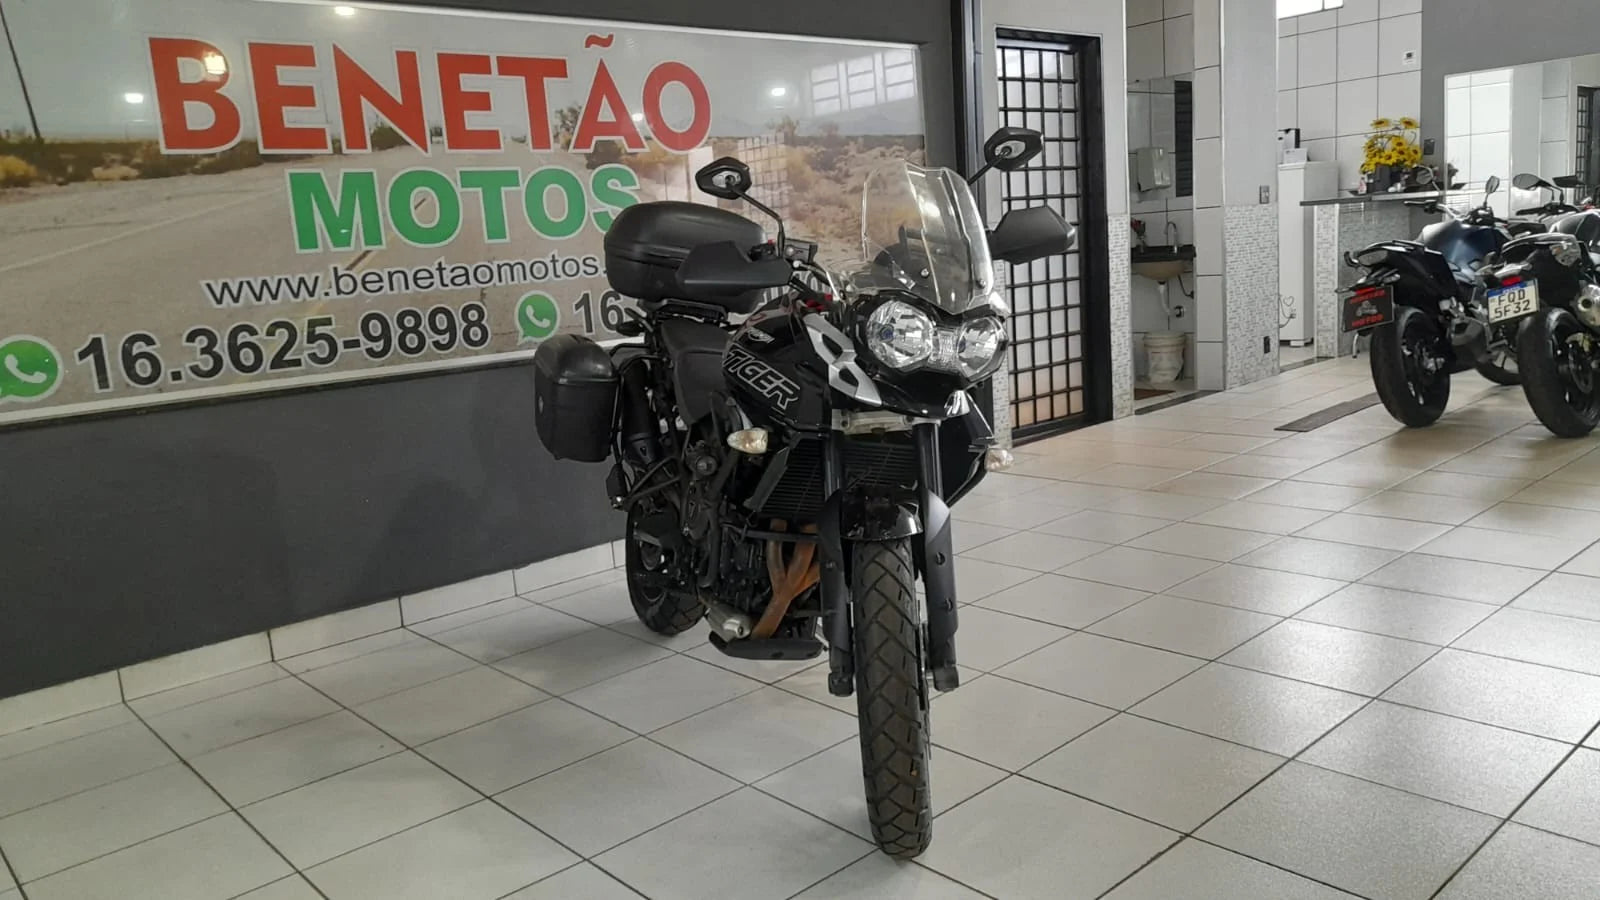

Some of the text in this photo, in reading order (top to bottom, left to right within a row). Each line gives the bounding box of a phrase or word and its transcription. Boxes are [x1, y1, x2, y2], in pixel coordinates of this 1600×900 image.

[149, 34, 711, 156] BENETÃO
[287, 165, 640, 253] MOTOS
[76, 302, 491, 392] 16.3625-9898
[722, 343, 801, 410] TIGER
